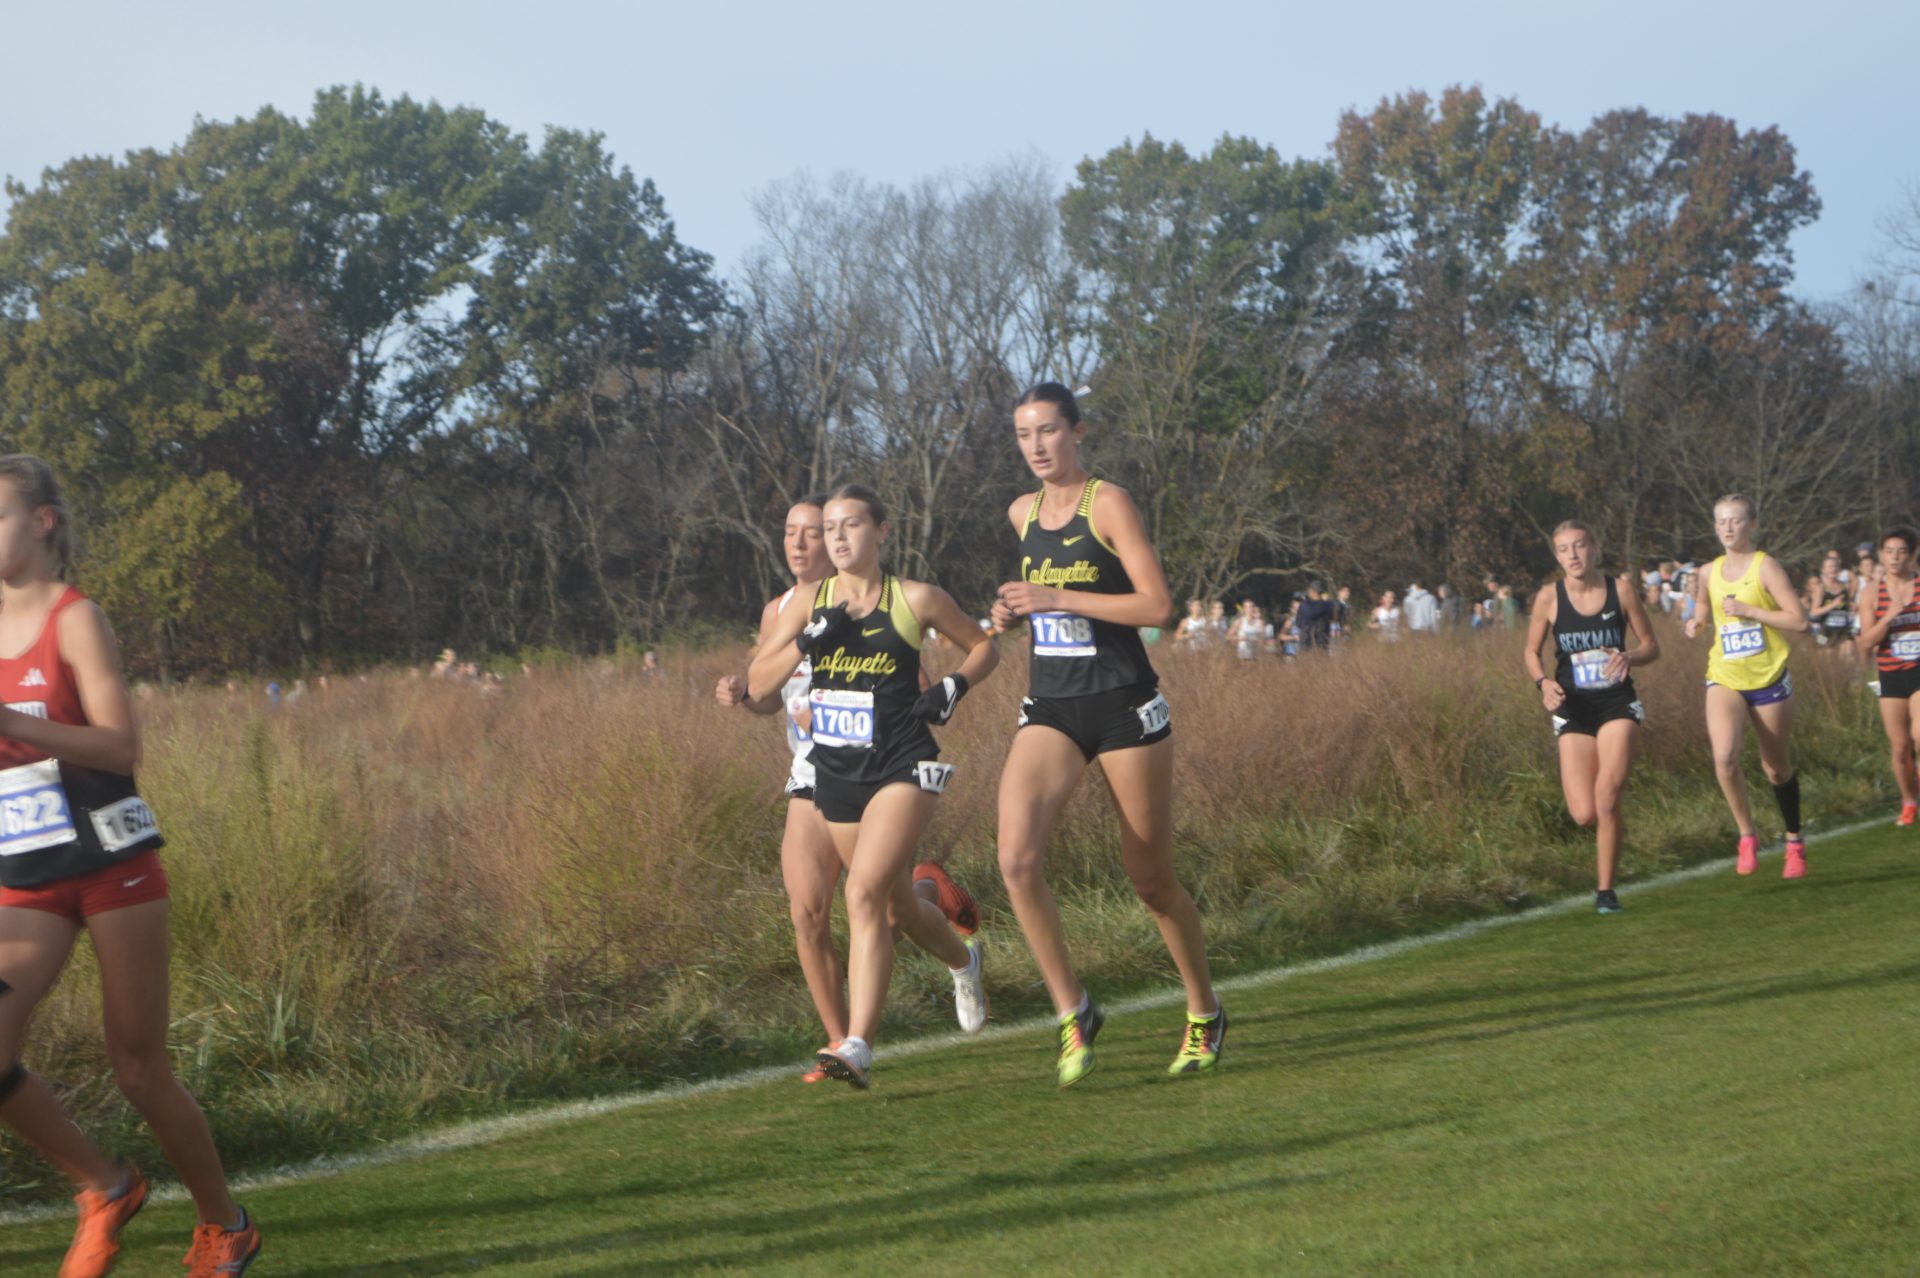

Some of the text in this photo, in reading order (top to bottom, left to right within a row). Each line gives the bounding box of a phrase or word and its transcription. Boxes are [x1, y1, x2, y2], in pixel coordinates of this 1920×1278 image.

[1021, 555, 1099, 591] Lafayette
[1033, 617, 1092, 643] 1708
[1559, 627, 1621, 652] SECKMAN
[1723, 630, 1763, 652] 1643
[814, 706, 871, 737] 1700
